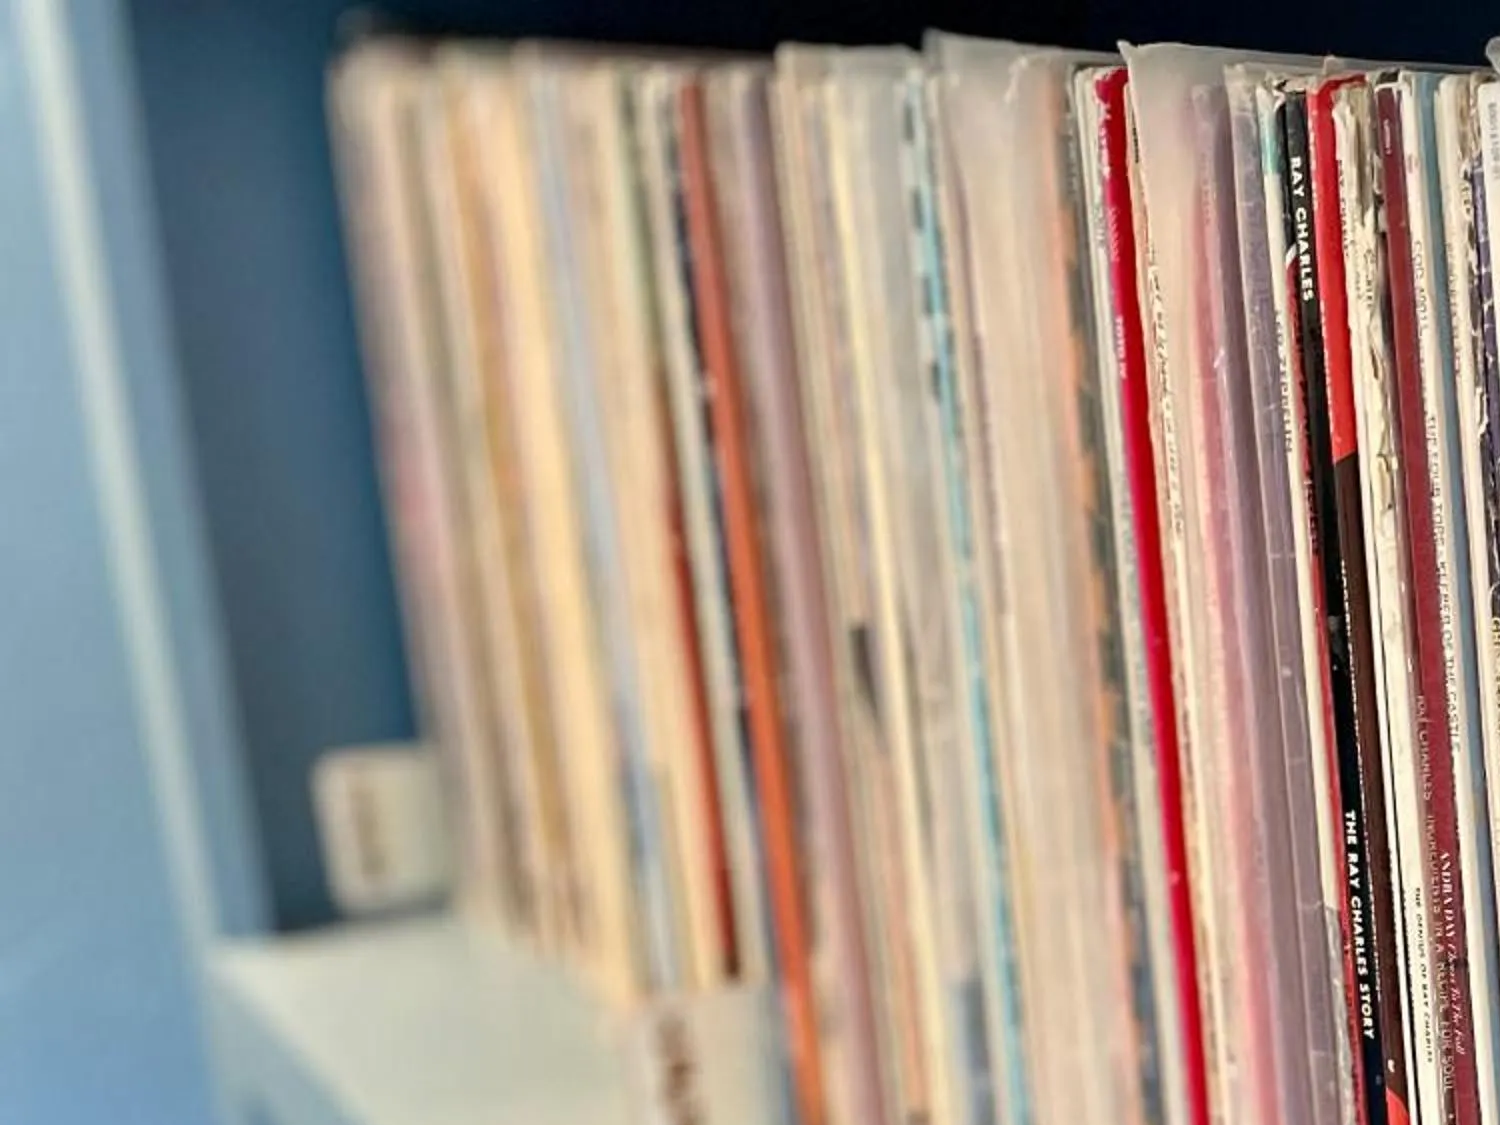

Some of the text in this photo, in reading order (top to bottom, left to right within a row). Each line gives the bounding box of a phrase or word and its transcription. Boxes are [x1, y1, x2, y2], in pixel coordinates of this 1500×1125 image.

[1290, 155, 1315, 302] RAY CHARLES
[1344, 809, 1376, 1040] THE RAY CHARLES STORY
[1443, 908, 1457, 943] DAY
[1443, 1052, 1456, 1092] SOUL
